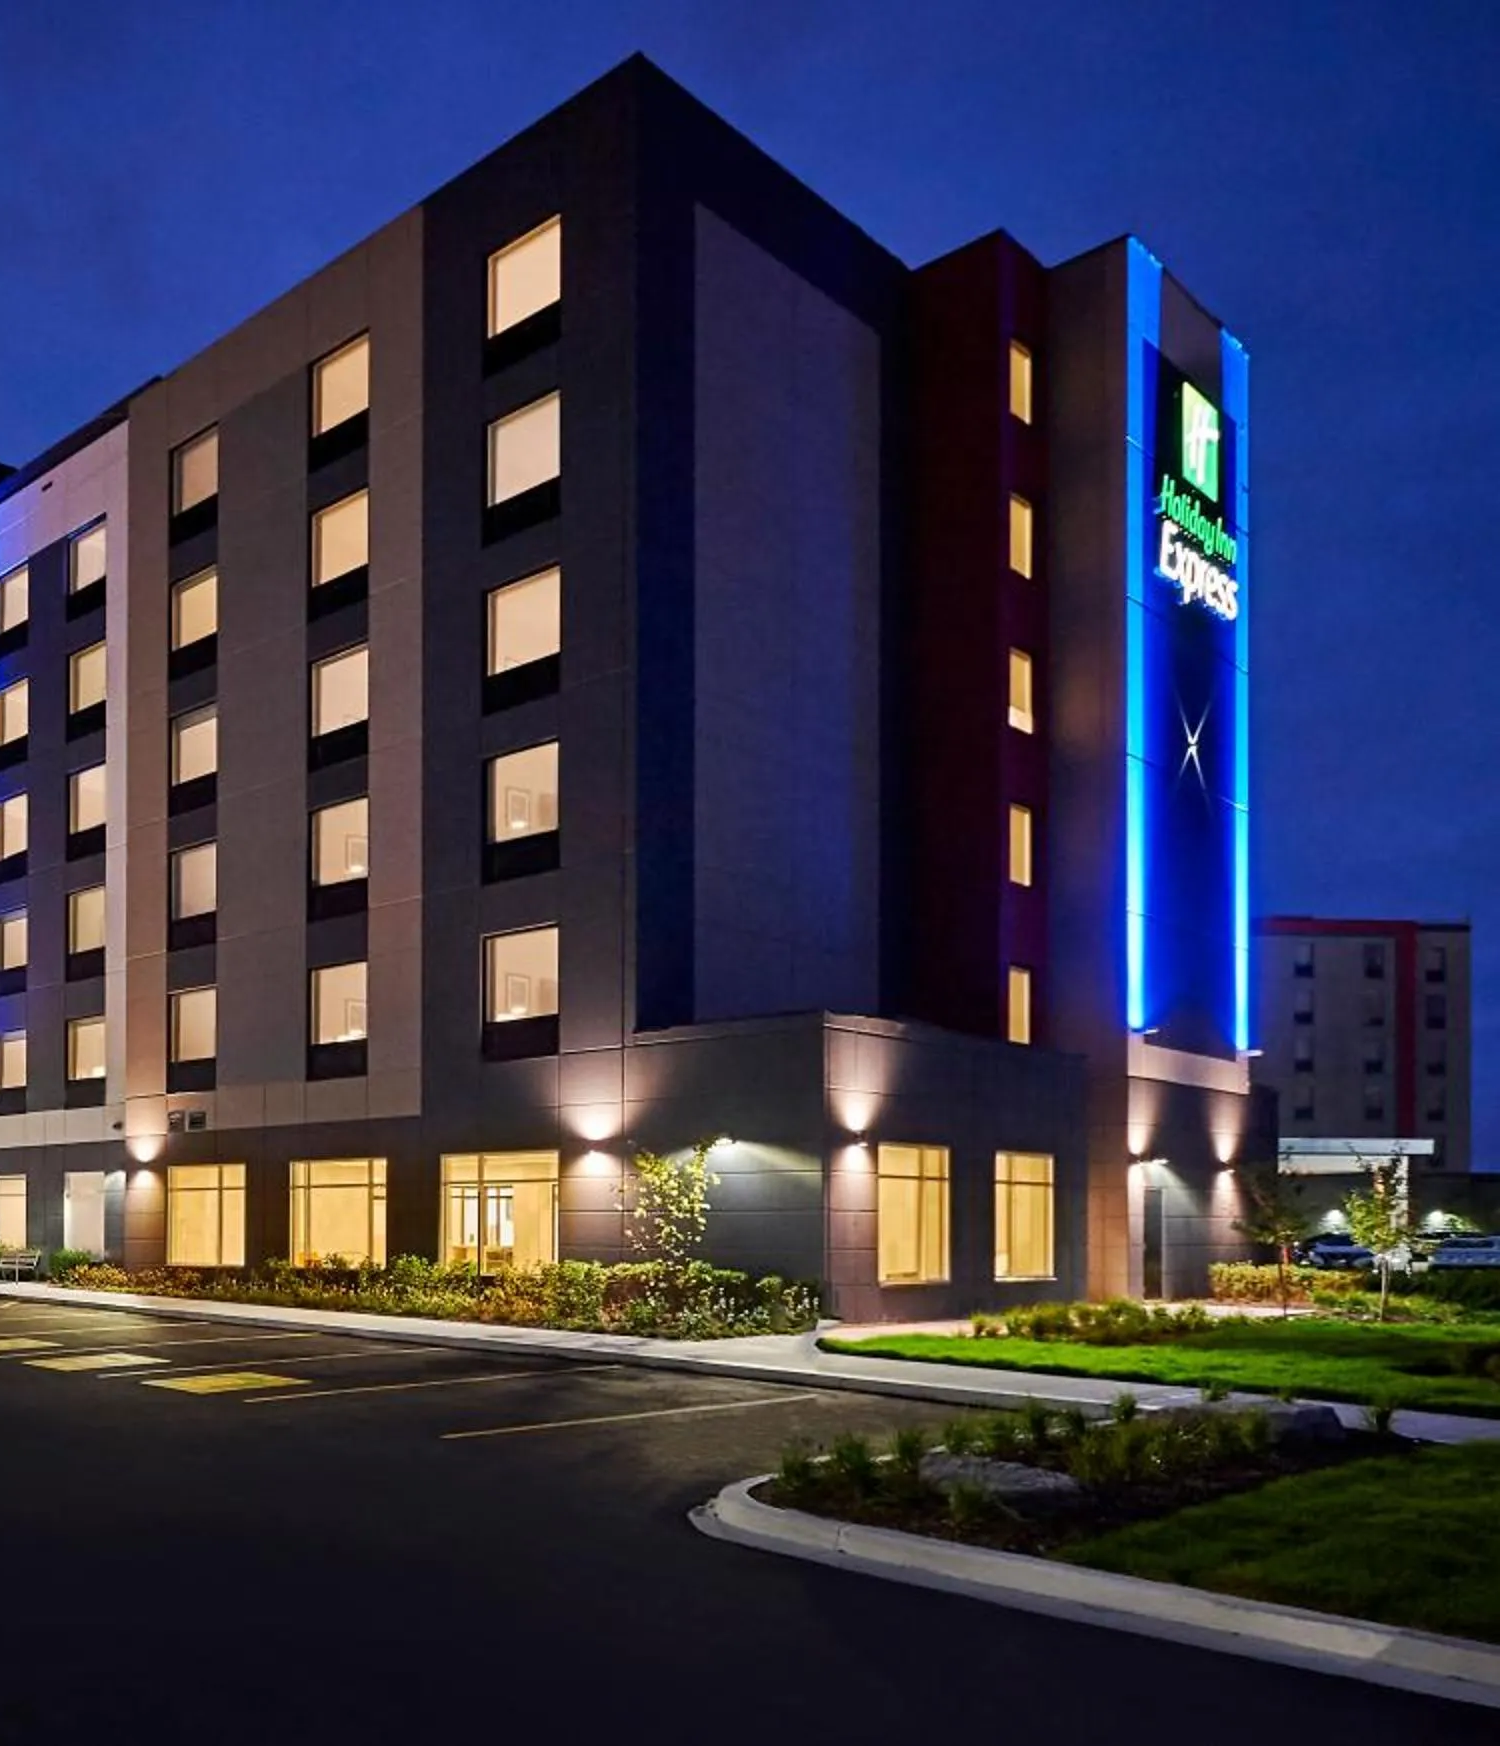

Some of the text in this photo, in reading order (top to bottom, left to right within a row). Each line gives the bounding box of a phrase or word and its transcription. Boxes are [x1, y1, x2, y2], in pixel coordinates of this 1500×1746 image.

[1160, 474, 1237, 564] Holiday Inn
[1158, 518, 1239, 621] Express
